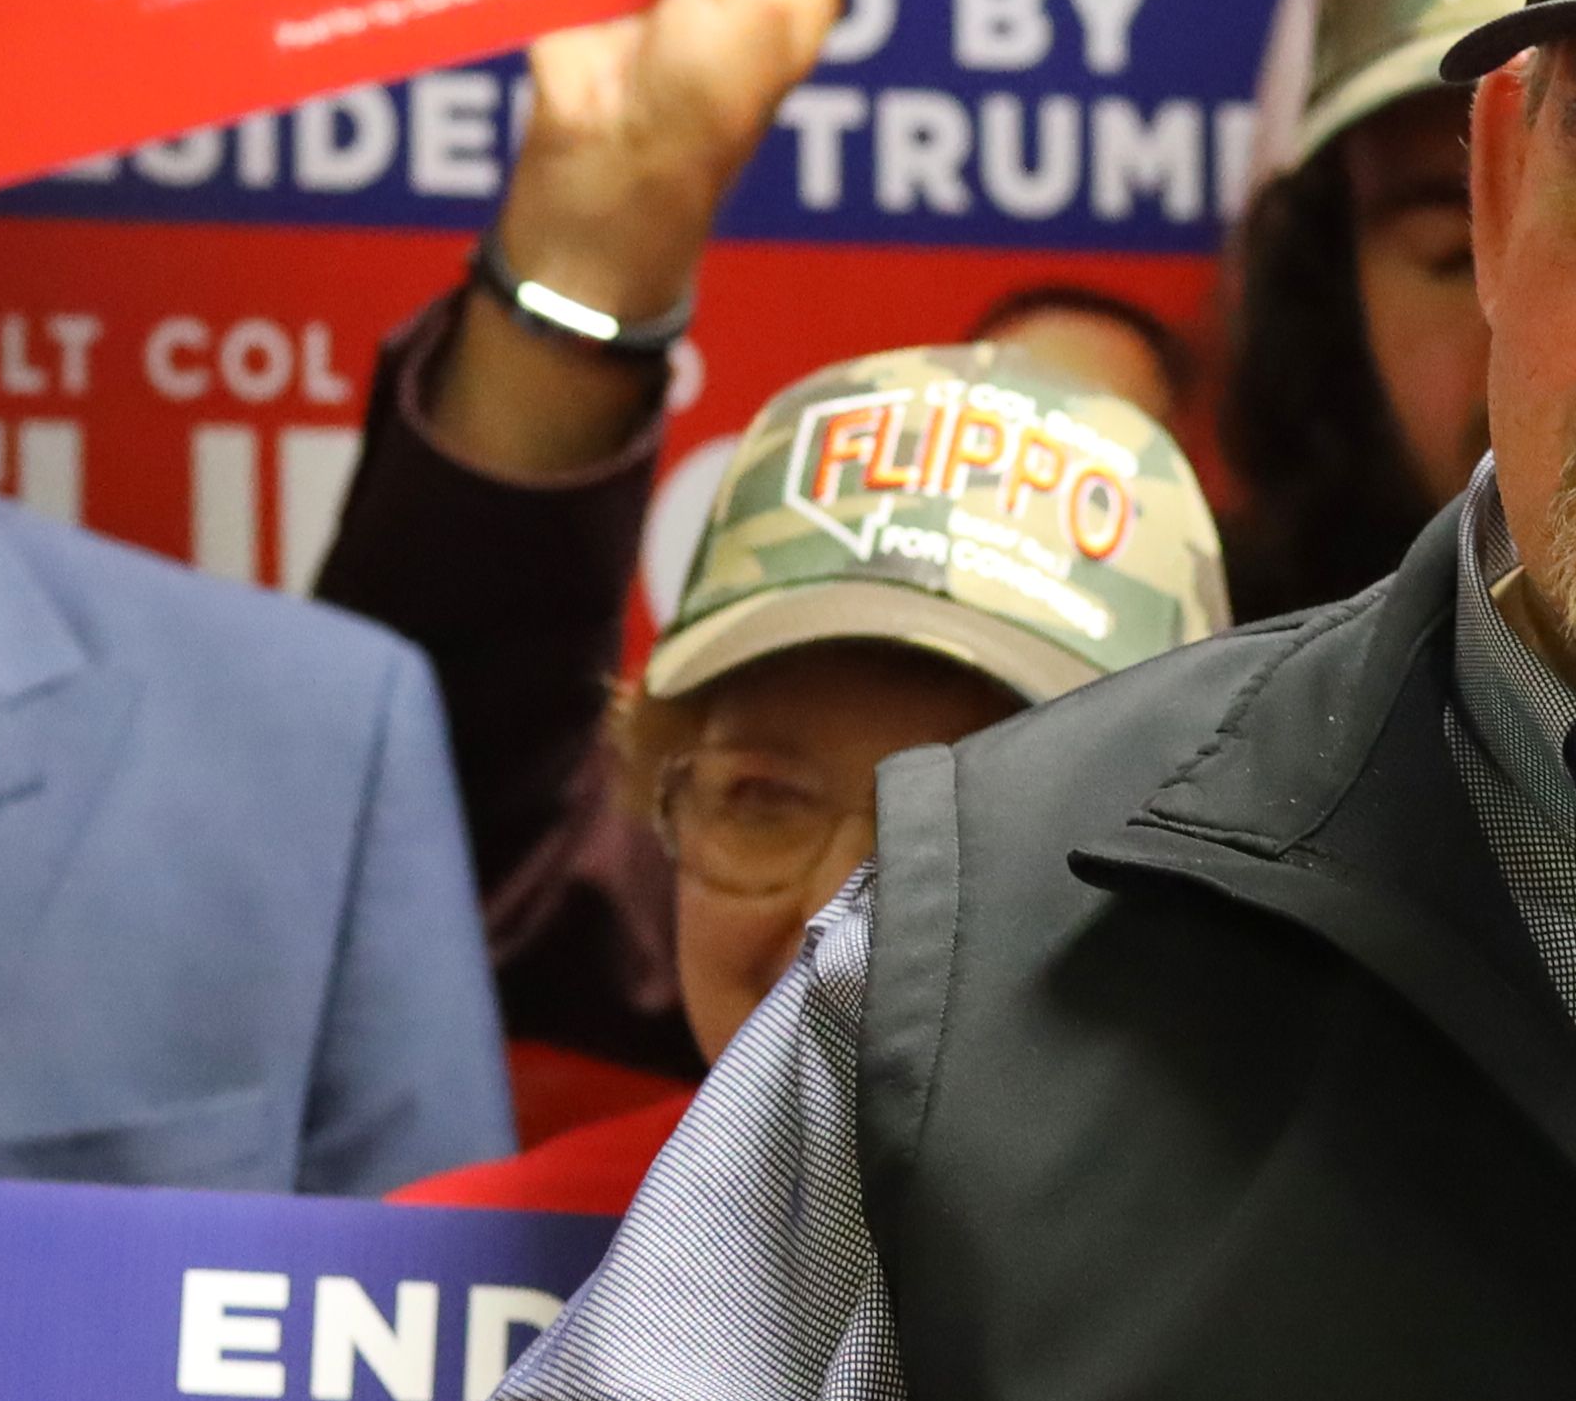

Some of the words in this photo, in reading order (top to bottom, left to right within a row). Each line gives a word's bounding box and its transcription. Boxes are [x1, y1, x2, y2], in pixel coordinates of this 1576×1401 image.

[0, 311, 101, 396] LT
[143, 315, 351, 403] COL
[812, 402, 1138, 561] FLIPPO
[881, 526, 948, 563] FOR
